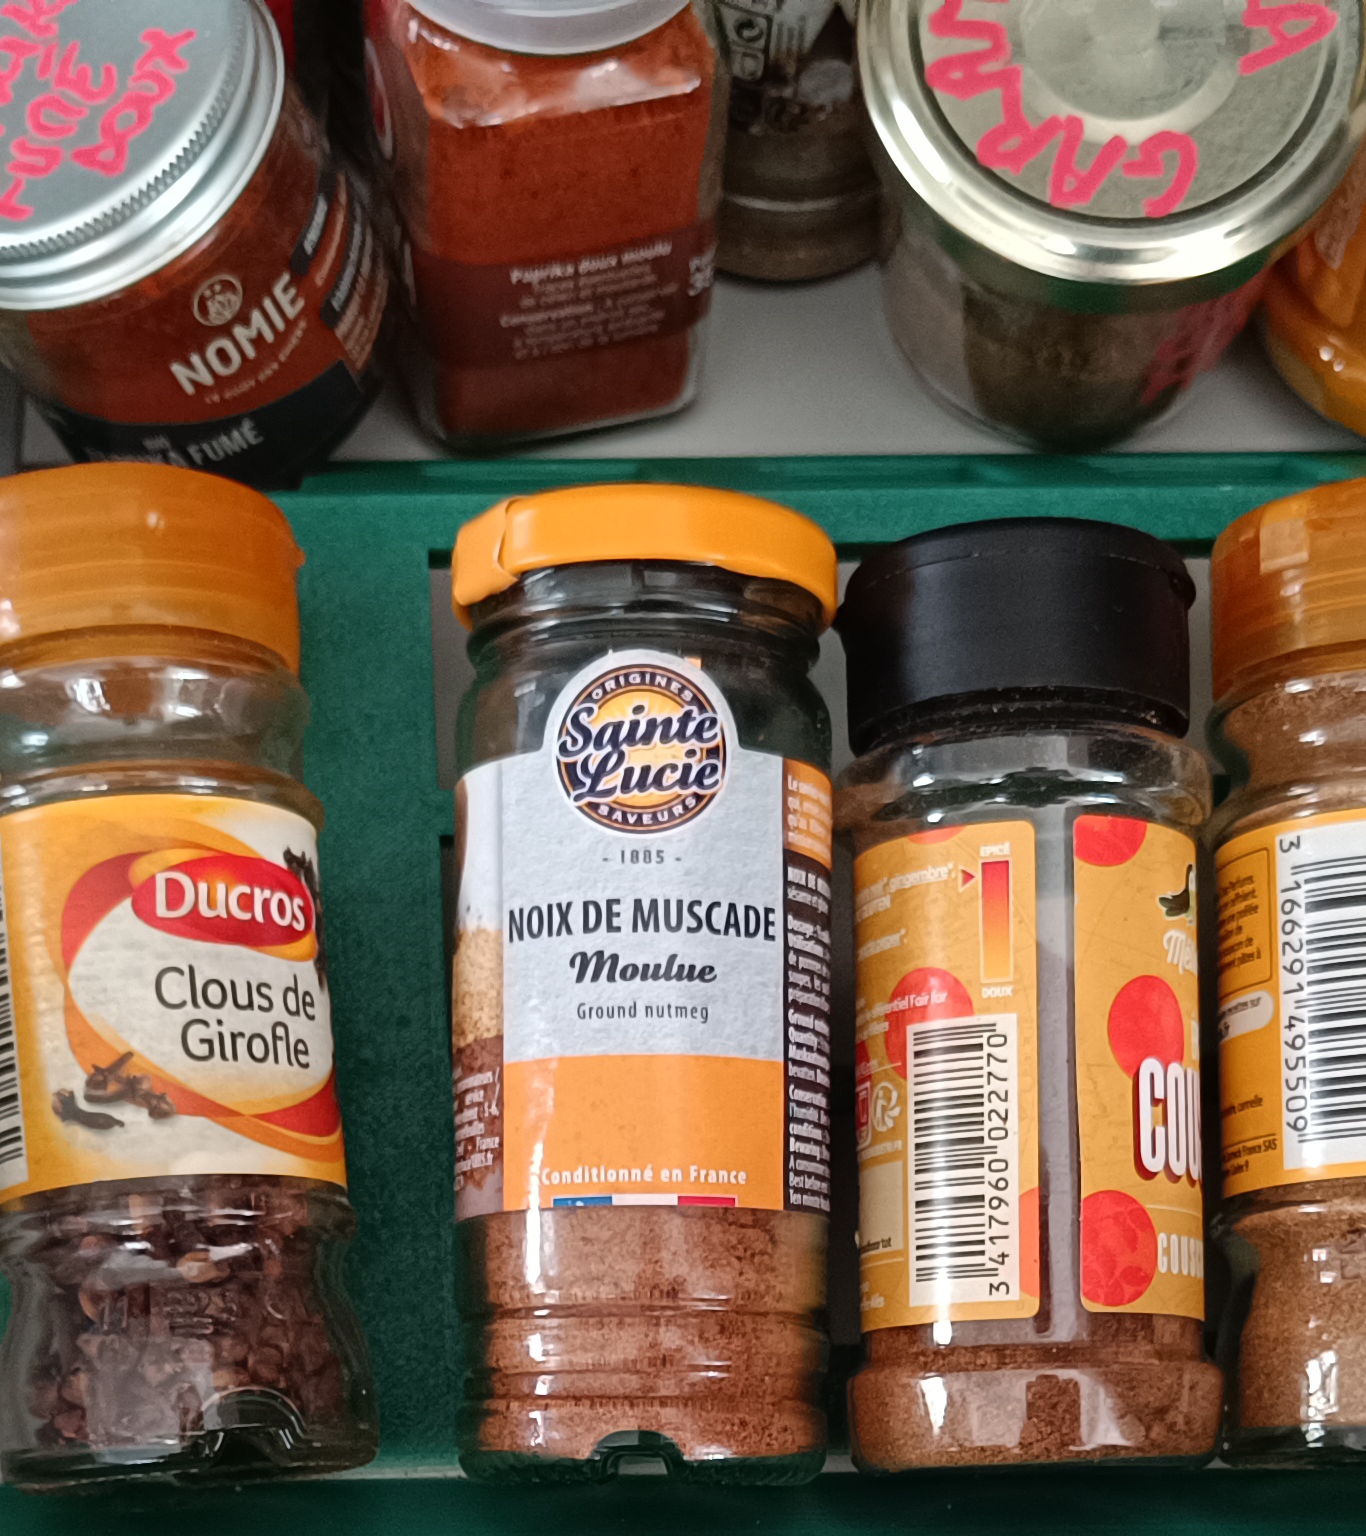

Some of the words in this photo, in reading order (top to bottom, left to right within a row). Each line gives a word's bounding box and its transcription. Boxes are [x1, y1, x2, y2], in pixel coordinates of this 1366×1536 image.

[169, 271, 306, 396] NOMIE
[591, 671, 693, 701] ORIGINES
[558, 703, 719, 758] Sainte
[572, 747, 721, 803] Lucie
[597, 794, 698, 825] SAVEURS
[1279, 835, 1301, 853] 3
[154, 870, 306, 931] Ducros
[508, 900, 573, 944] NOIX
[582, 898, 621, 934] DE
[631, 898, 776, 942] MUSCADE
[1280, 879, 1304, 996] 166291
[154, 964, 274, 1010] Clous
[283, 974, 316, 1021] de
[569, 950, 717, 984] Moulue
[982, 984, 1013, 999] DOUX
[577, 1001, 637, 1020] Ground
[644, 1004, 710, 1023] nutmeg
[181, 1018, 310, 1069] Girofle
[986, 1033, 1009, 1141] 022770
[1283, 1013, 1309, 1134] 495509
[541, 1163, 653, 1186] Conditionné
[660, 1169, 683, 1183] en
[689, 1165, 747, 1185] France
[987, 1157, 1010, 1270] 417960
[988, 1282, 1011, 1297] 3
